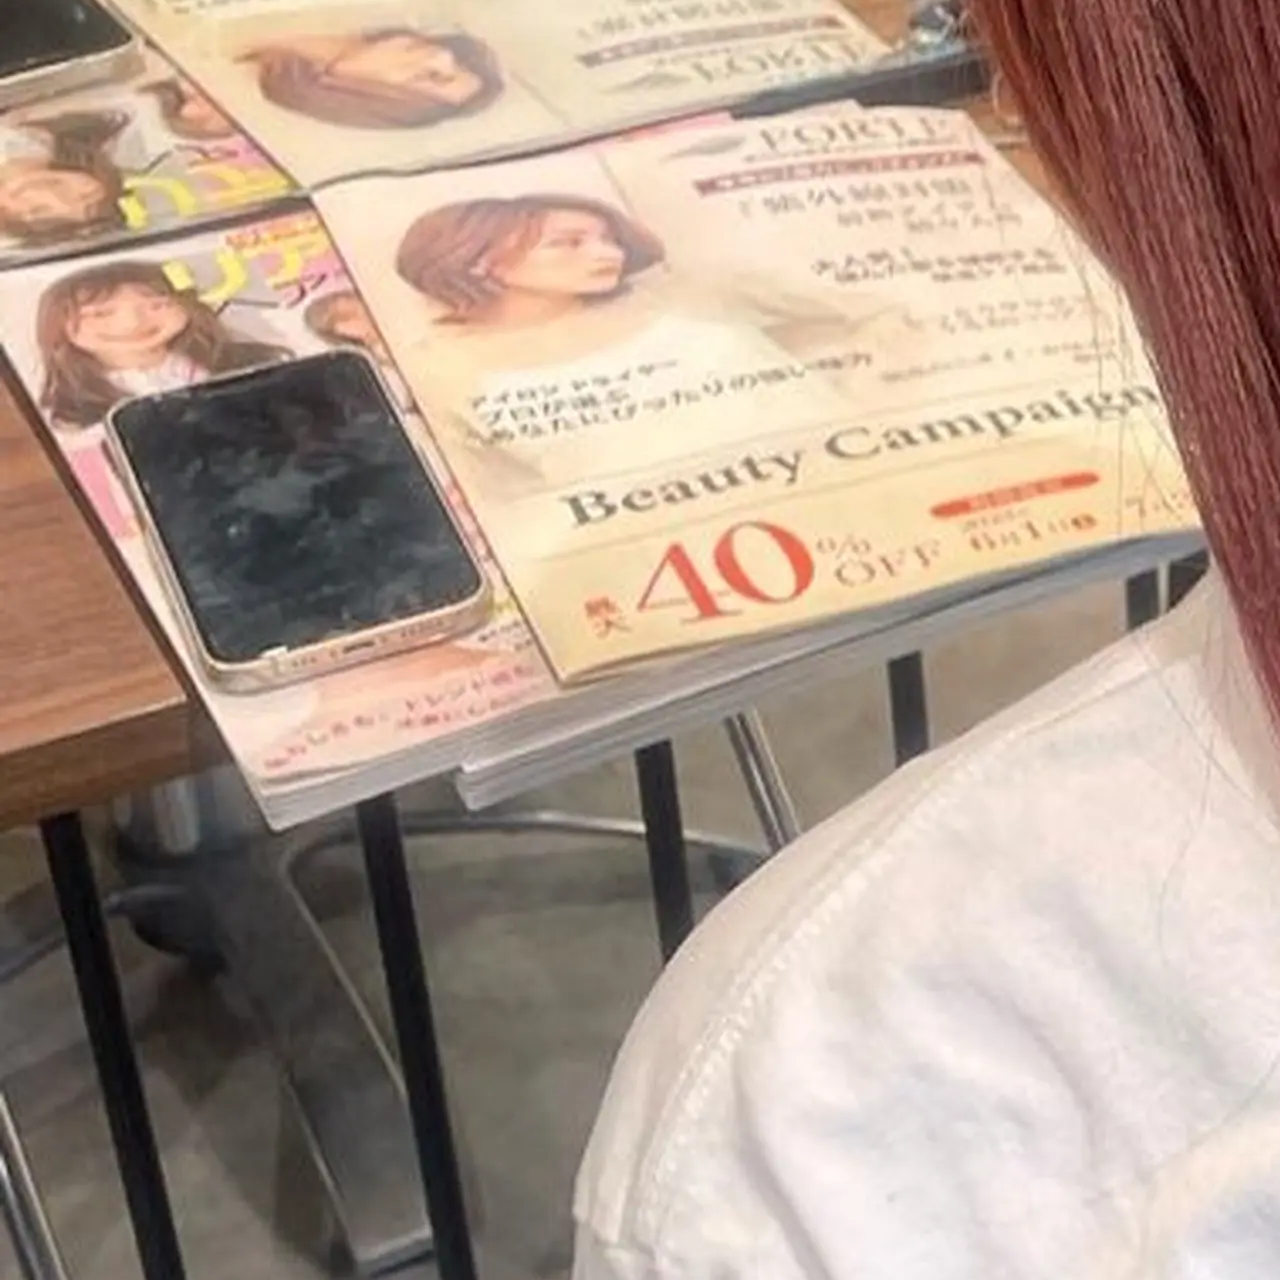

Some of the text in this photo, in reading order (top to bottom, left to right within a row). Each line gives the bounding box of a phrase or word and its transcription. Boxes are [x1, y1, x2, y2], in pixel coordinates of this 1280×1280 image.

[561, 381, 1163, 528] Beauty Campaign
[636, 519, 816, 623] 40
